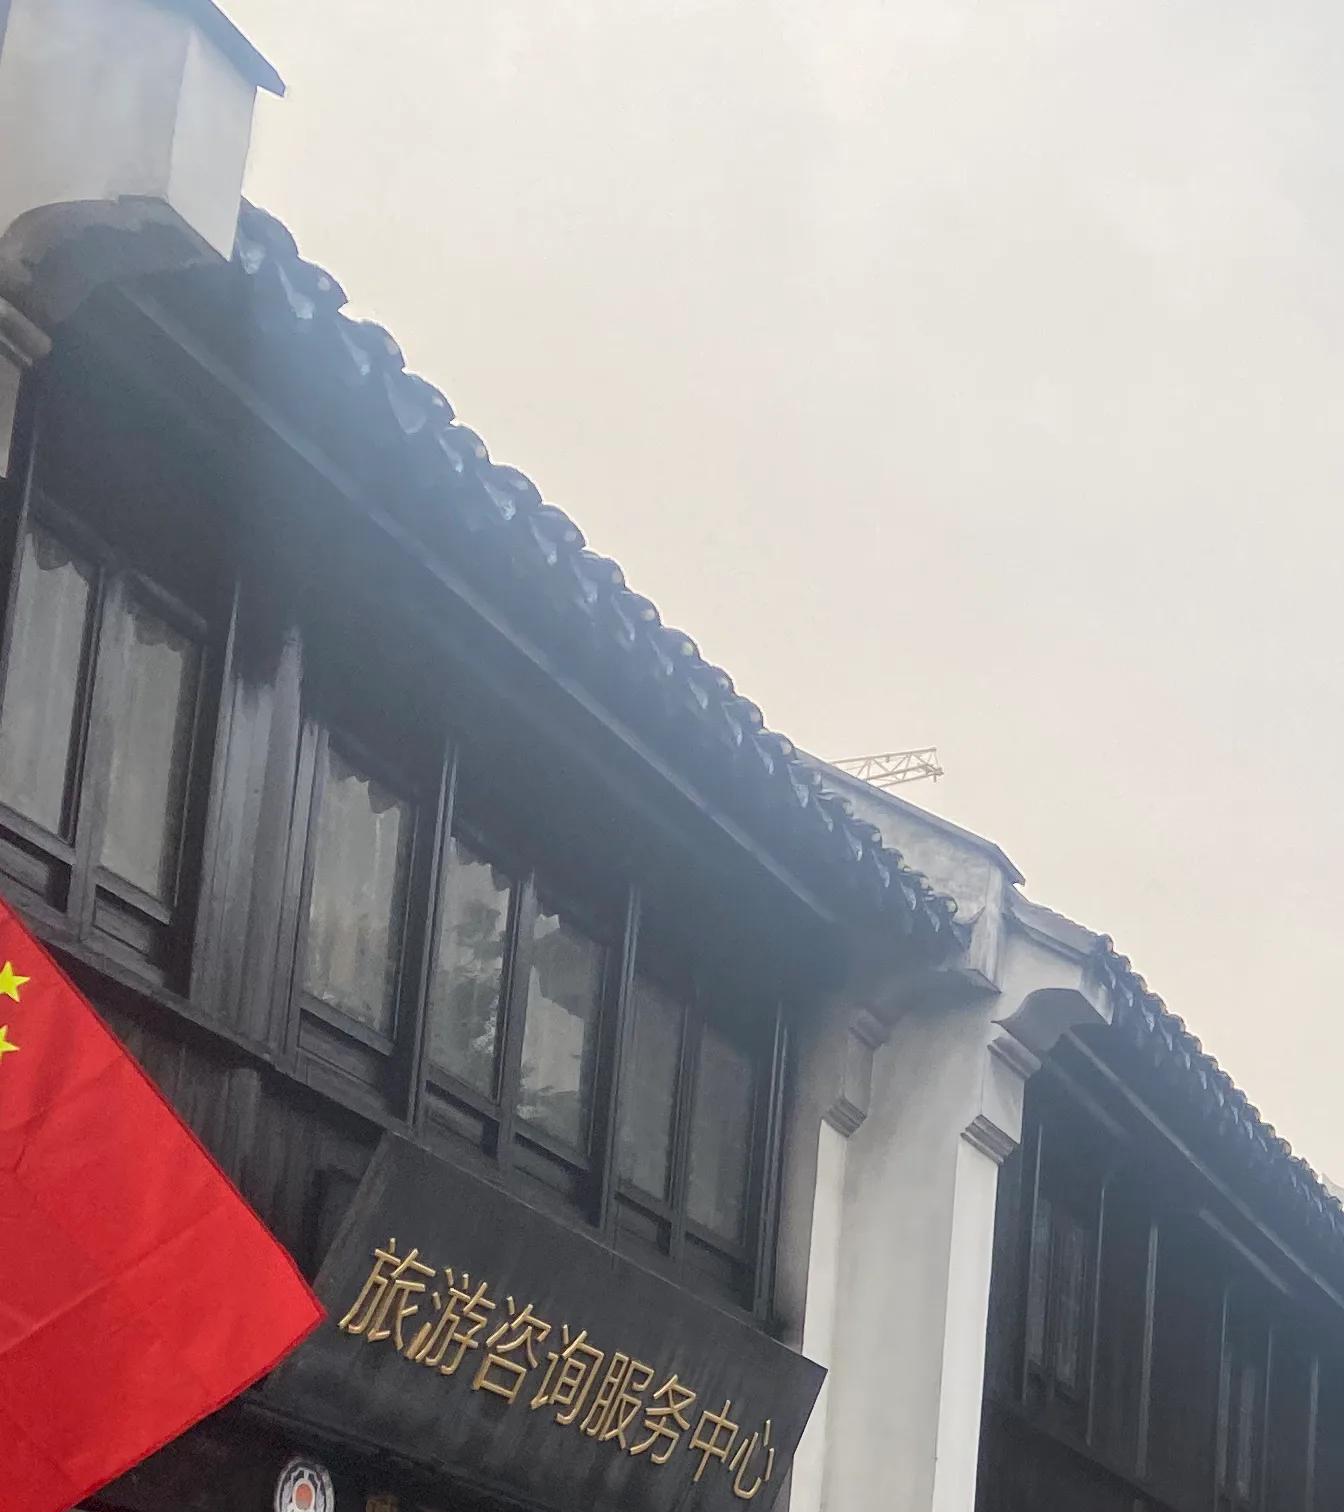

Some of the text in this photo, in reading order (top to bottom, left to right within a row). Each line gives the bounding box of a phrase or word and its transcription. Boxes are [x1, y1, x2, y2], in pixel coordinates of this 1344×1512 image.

[339, 1238, 774, 1499] 旅游咨询服务中心
